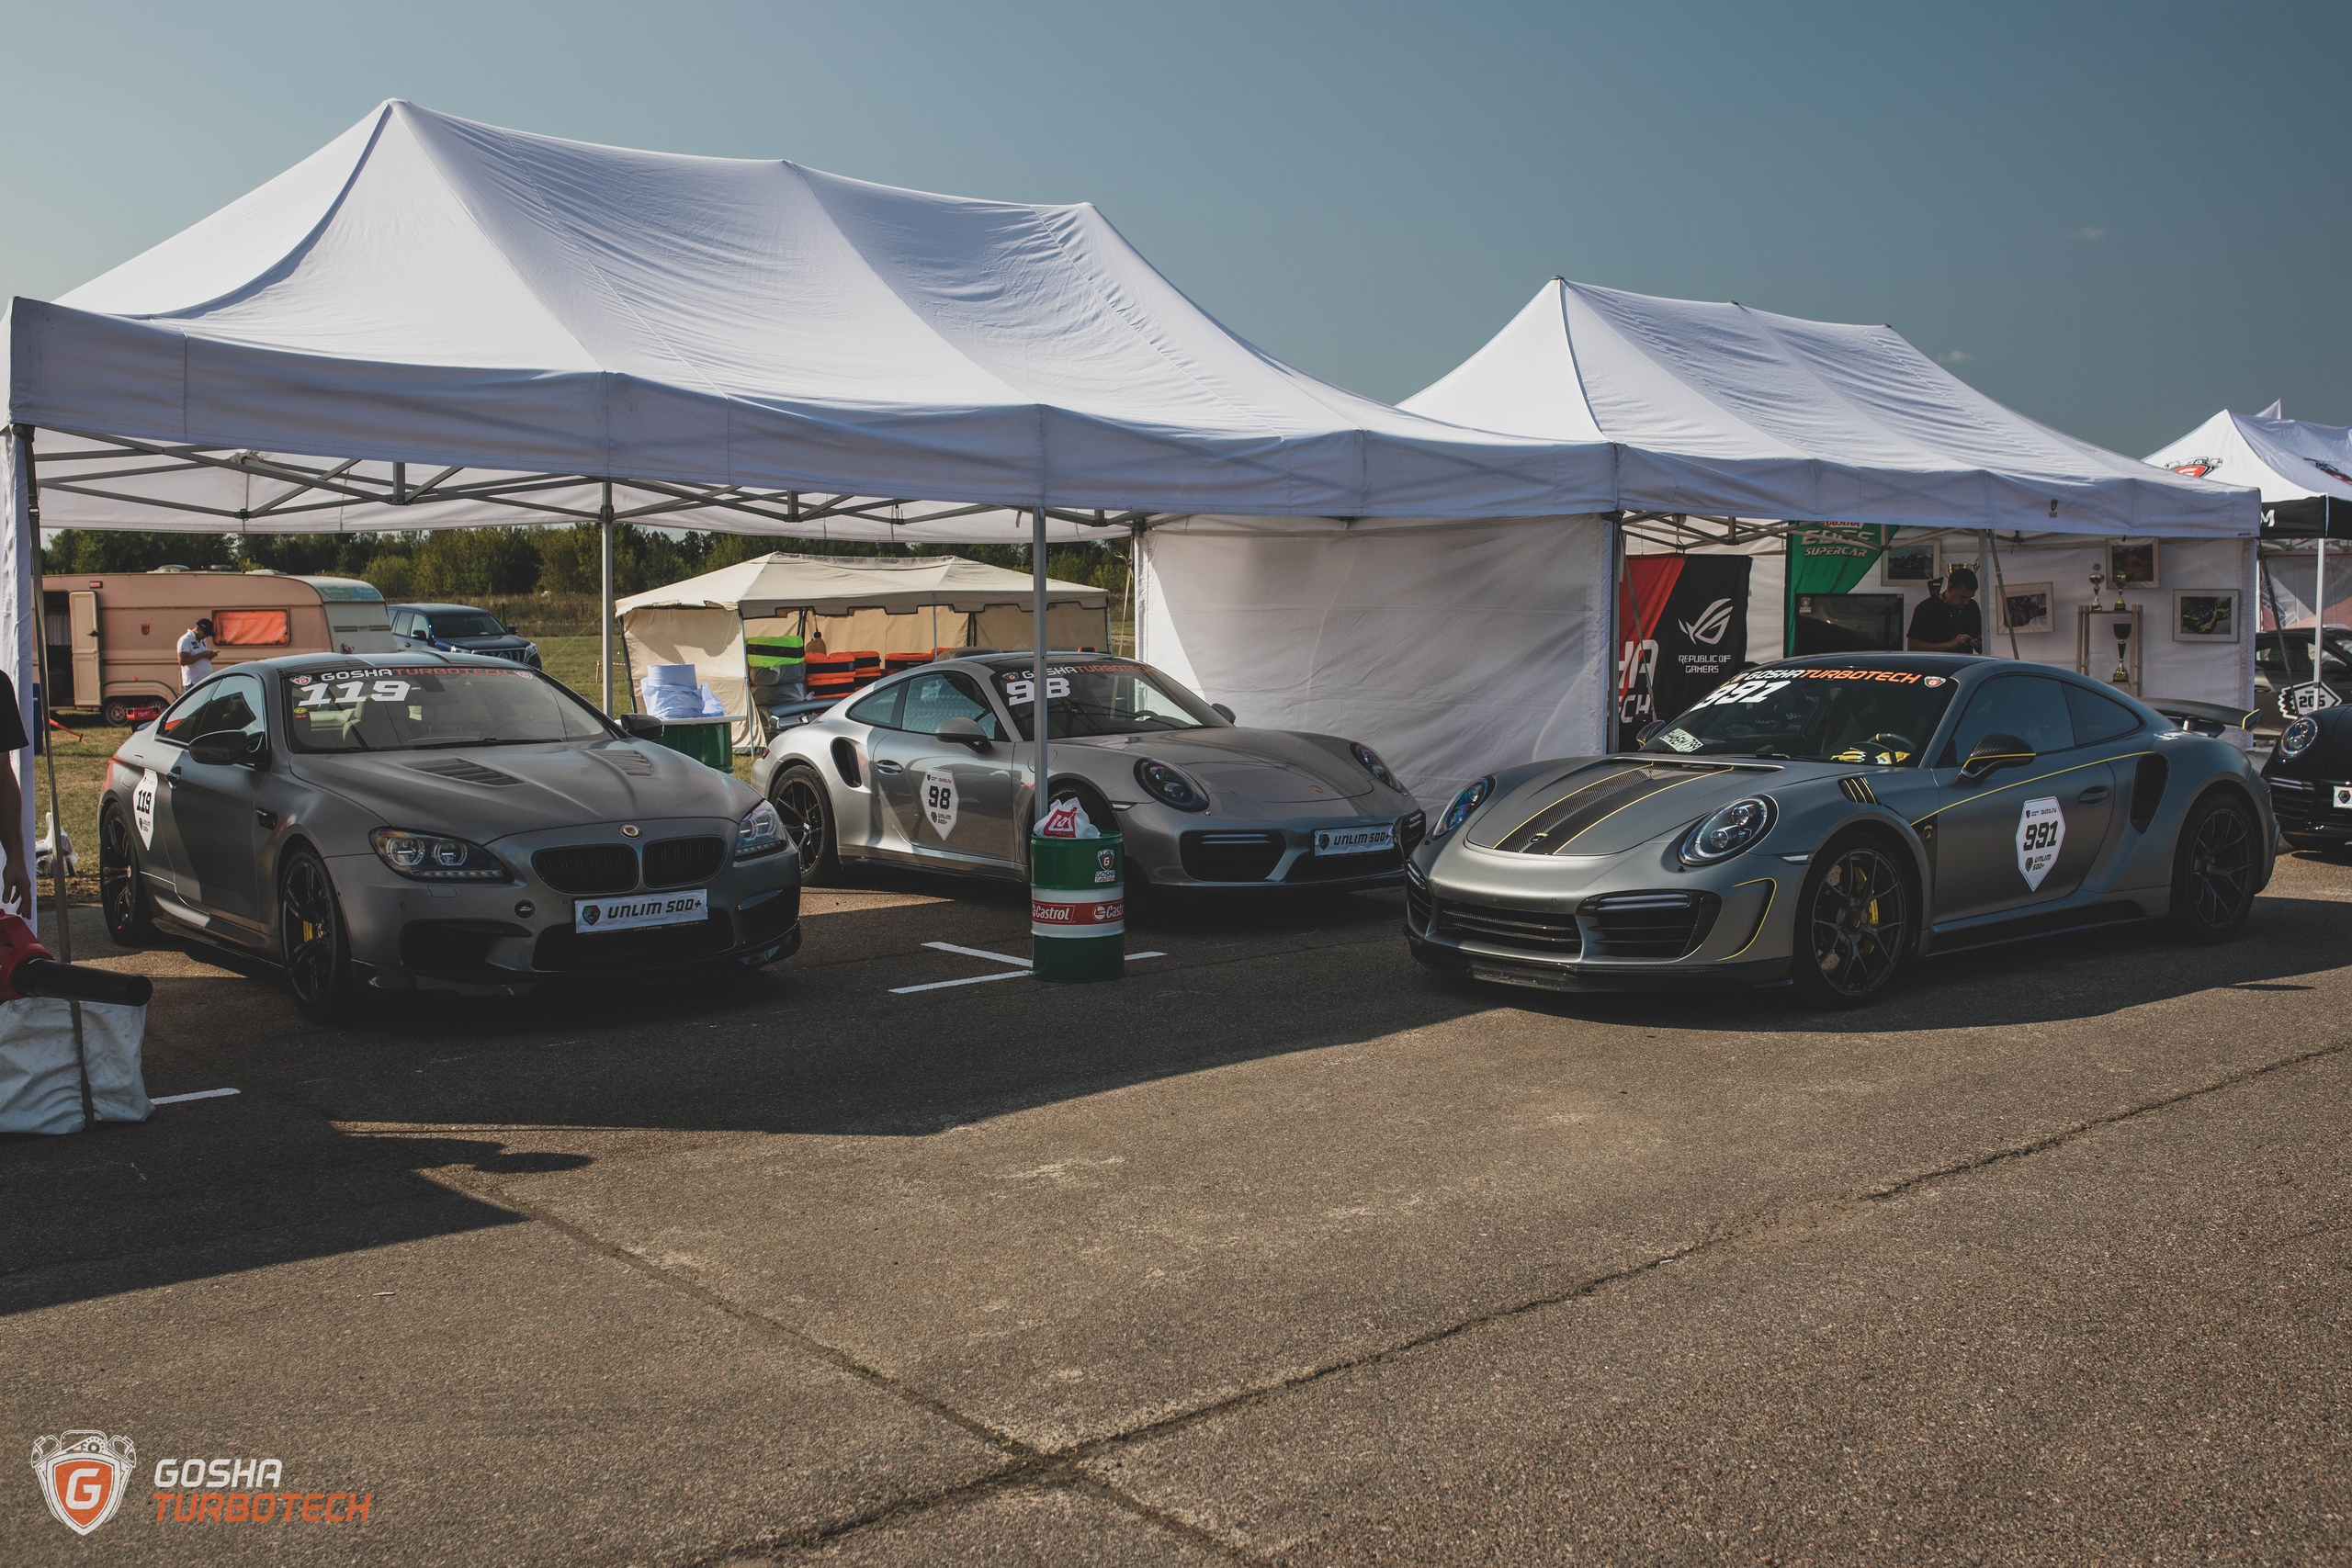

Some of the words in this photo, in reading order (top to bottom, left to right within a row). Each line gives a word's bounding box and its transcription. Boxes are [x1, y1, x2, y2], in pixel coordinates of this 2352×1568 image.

[1804, 546, 1868, 558] SUPERCAR
[1678, 654, 1717, 664] REPUBLIC
[1718, 654, 1732, 663] OF
[1685, 665, 1719, 673] GAMERS
[298, 680, 412, 706] 119
[1006, 677, 1071, 706] 98
[1690, 680, 1792, 713] 991
[136, 789, 152, 815] 119
[928, 785, 951, 810] 98
[1333, 833, 1368, 846] UNLIM
[1369, 831, 1391, 842] 500+
[2023, 820, 2058, 852] 991
[1103, 856, 1110, 866] G
[2034, 854, 2052, 863] UNLIM
[2032, 863, 2045, 871] 500+
[607, 902, 662, 919] UNLIM
[665, 897, 702, 913] 500+
[1035, 905, 1069, 920] Castrol
